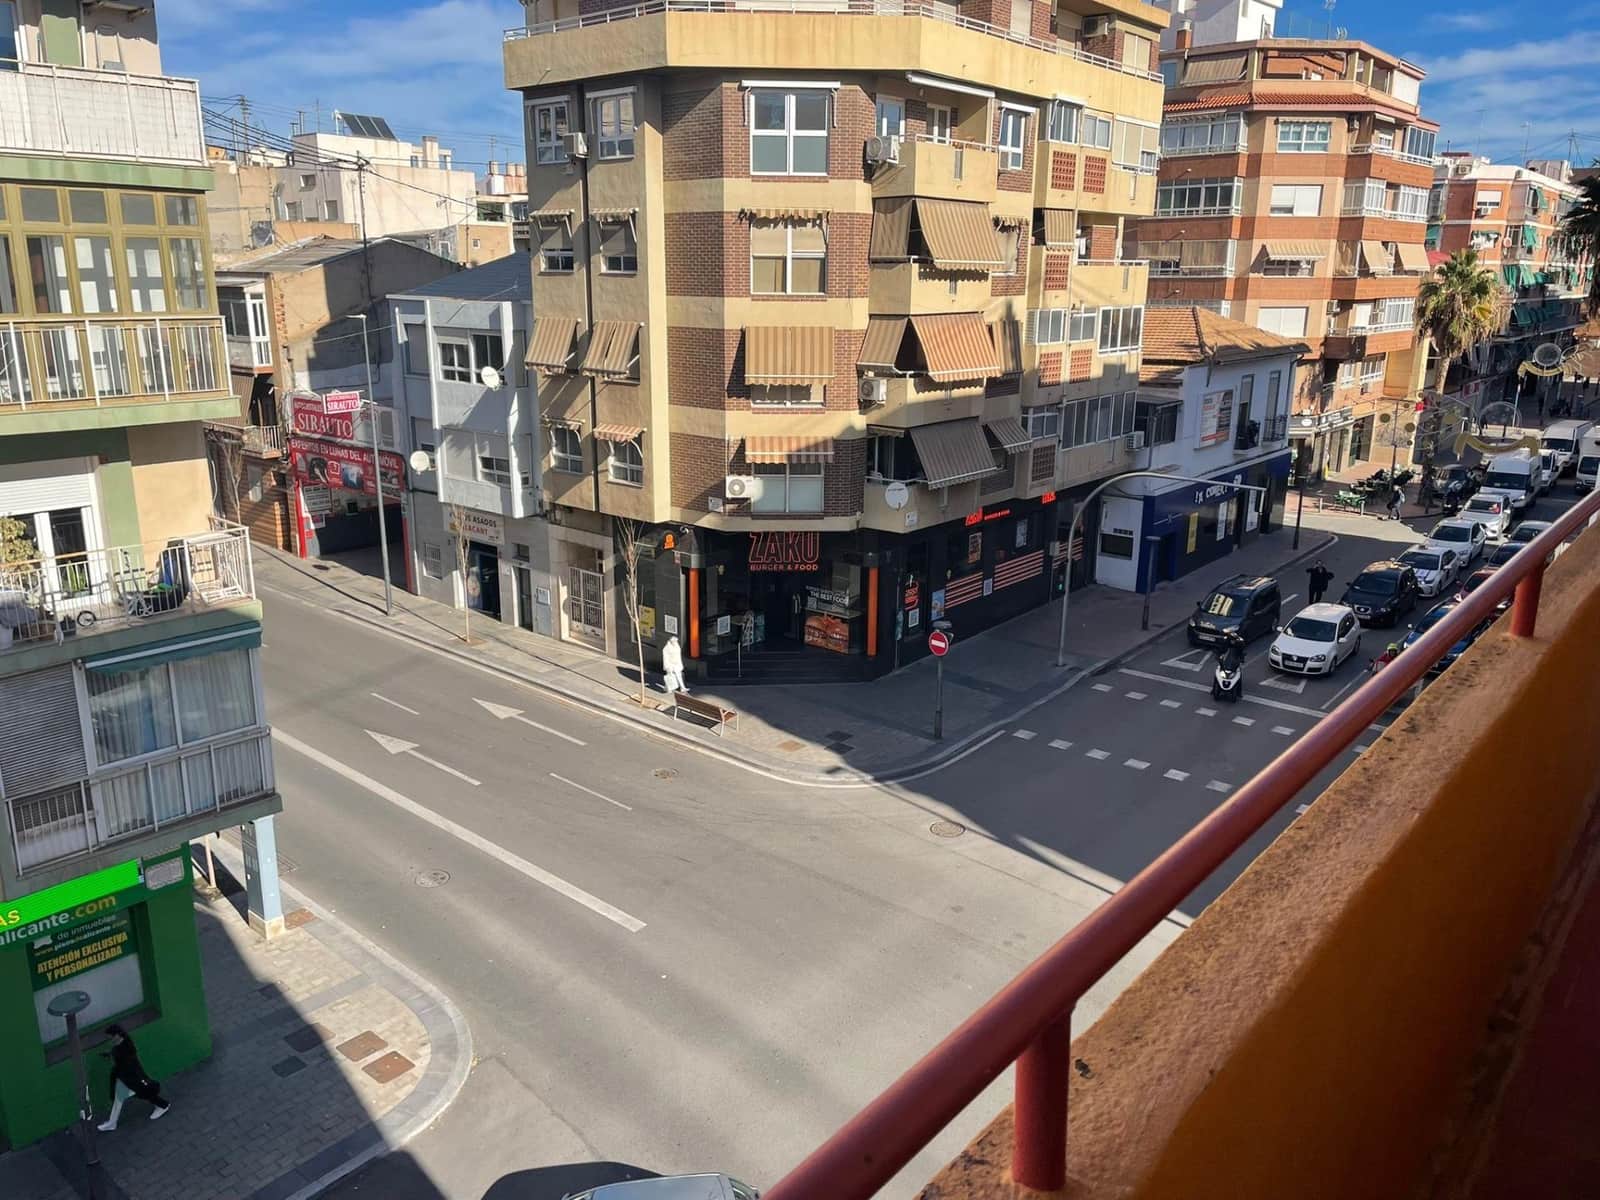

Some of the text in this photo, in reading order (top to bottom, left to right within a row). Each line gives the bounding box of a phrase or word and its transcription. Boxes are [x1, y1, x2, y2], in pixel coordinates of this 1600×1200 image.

[327, 400, 358, 411] SIRAUTO
[298, 412, 353, 438] SIRAUTO
[329, 446, 348, 460] LUNAS
[349, 450, 362, 461] DEL
[749, 531, 820, 563] ZAKU
[750, 563, 784, 571] BURGER
[795, 563, 818, 571] FOOD
[37, 931, 129, 974] ATENCIÓN EXCLUSIVA
[46, 945, 123, 983] Y PERSONALIZADA
